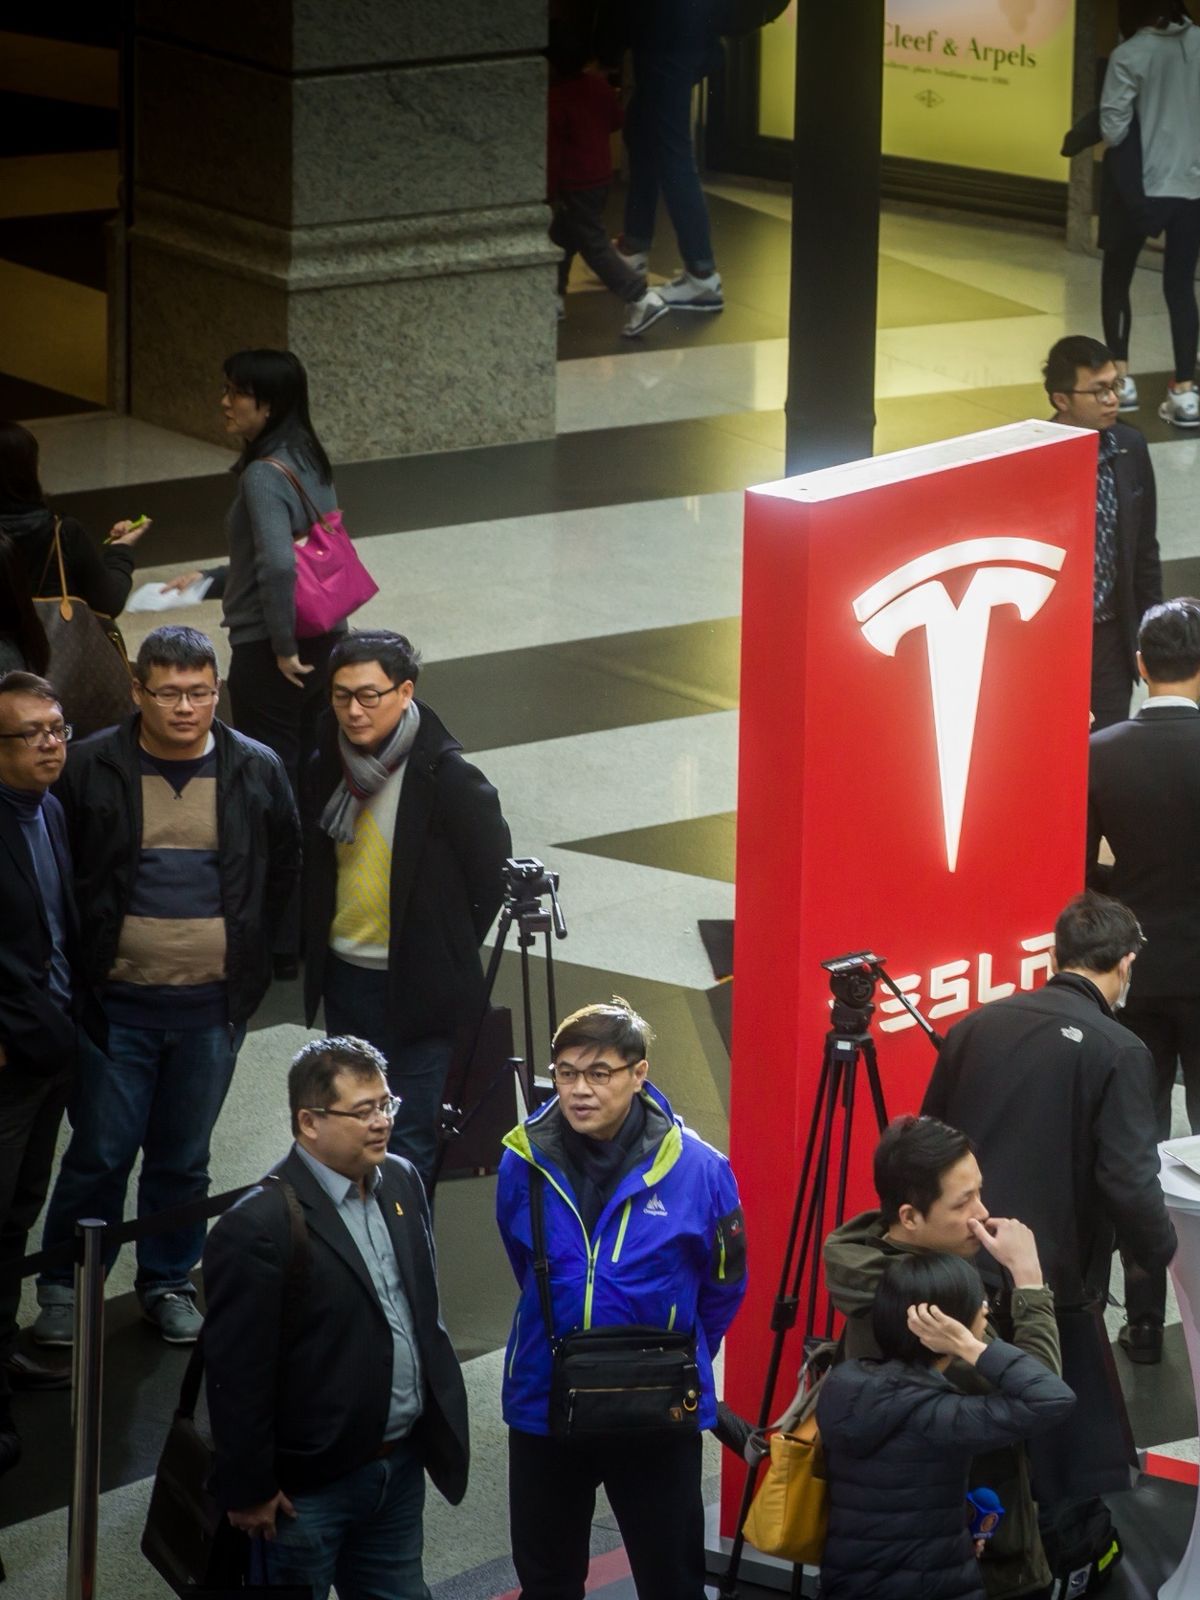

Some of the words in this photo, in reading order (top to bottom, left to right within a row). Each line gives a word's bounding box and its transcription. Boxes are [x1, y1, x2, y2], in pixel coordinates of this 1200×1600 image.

[943, 37, 958, 57] &
[967, 37, 1037, 71] Arpels
[828, 932, 1057, 1033] ESLA
